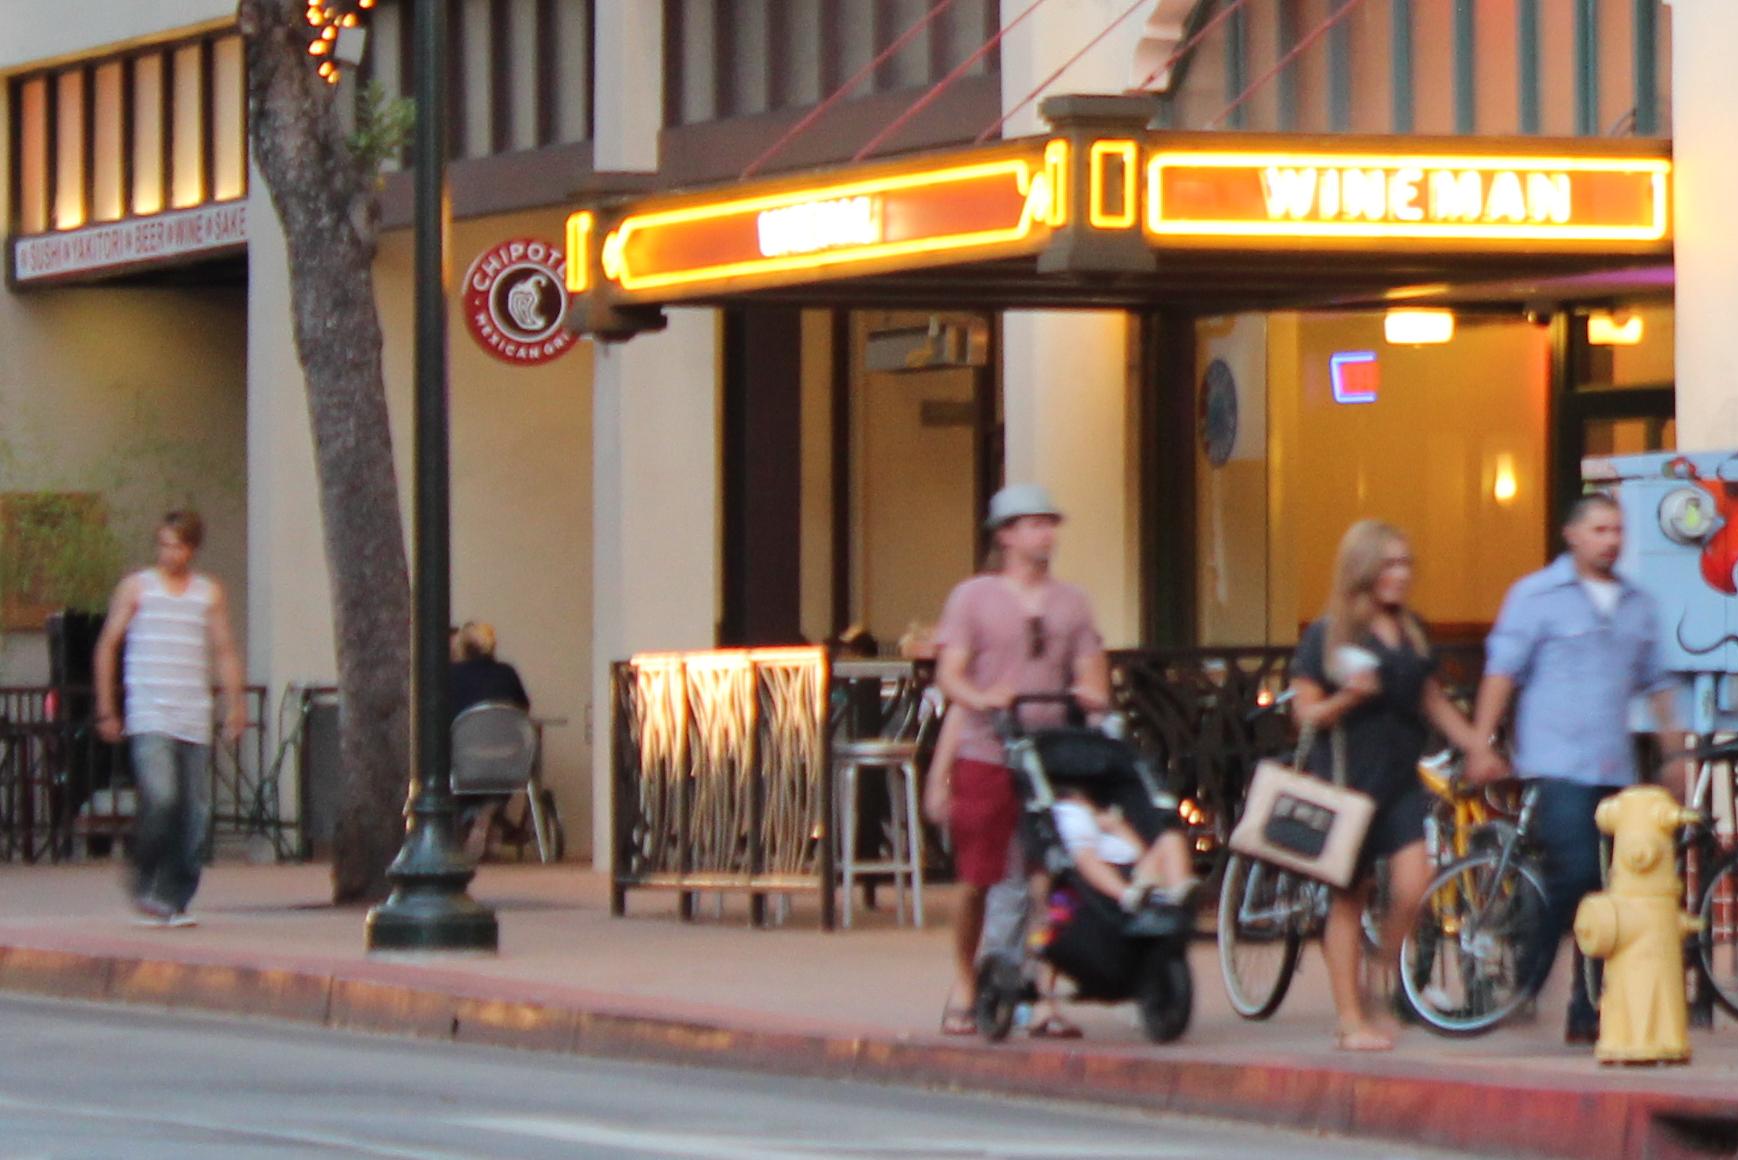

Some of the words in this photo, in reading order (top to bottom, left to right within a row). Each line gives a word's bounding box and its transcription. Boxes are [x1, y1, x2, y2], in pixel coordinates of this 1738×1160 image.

[1258, 166, 1572, 224] WINEMAN
[31, 238, 63, 271] SUSHI
[73, 228, 123, 262] YAKITORI
[136, 222, 164, 254] BEER
[174, 213, 203, 246] WINE
[216, 207, 246, 240] SAKE
[472, 243, 567, 292] CHIPOT
[475, 311, 540, 359] MEXICAN
